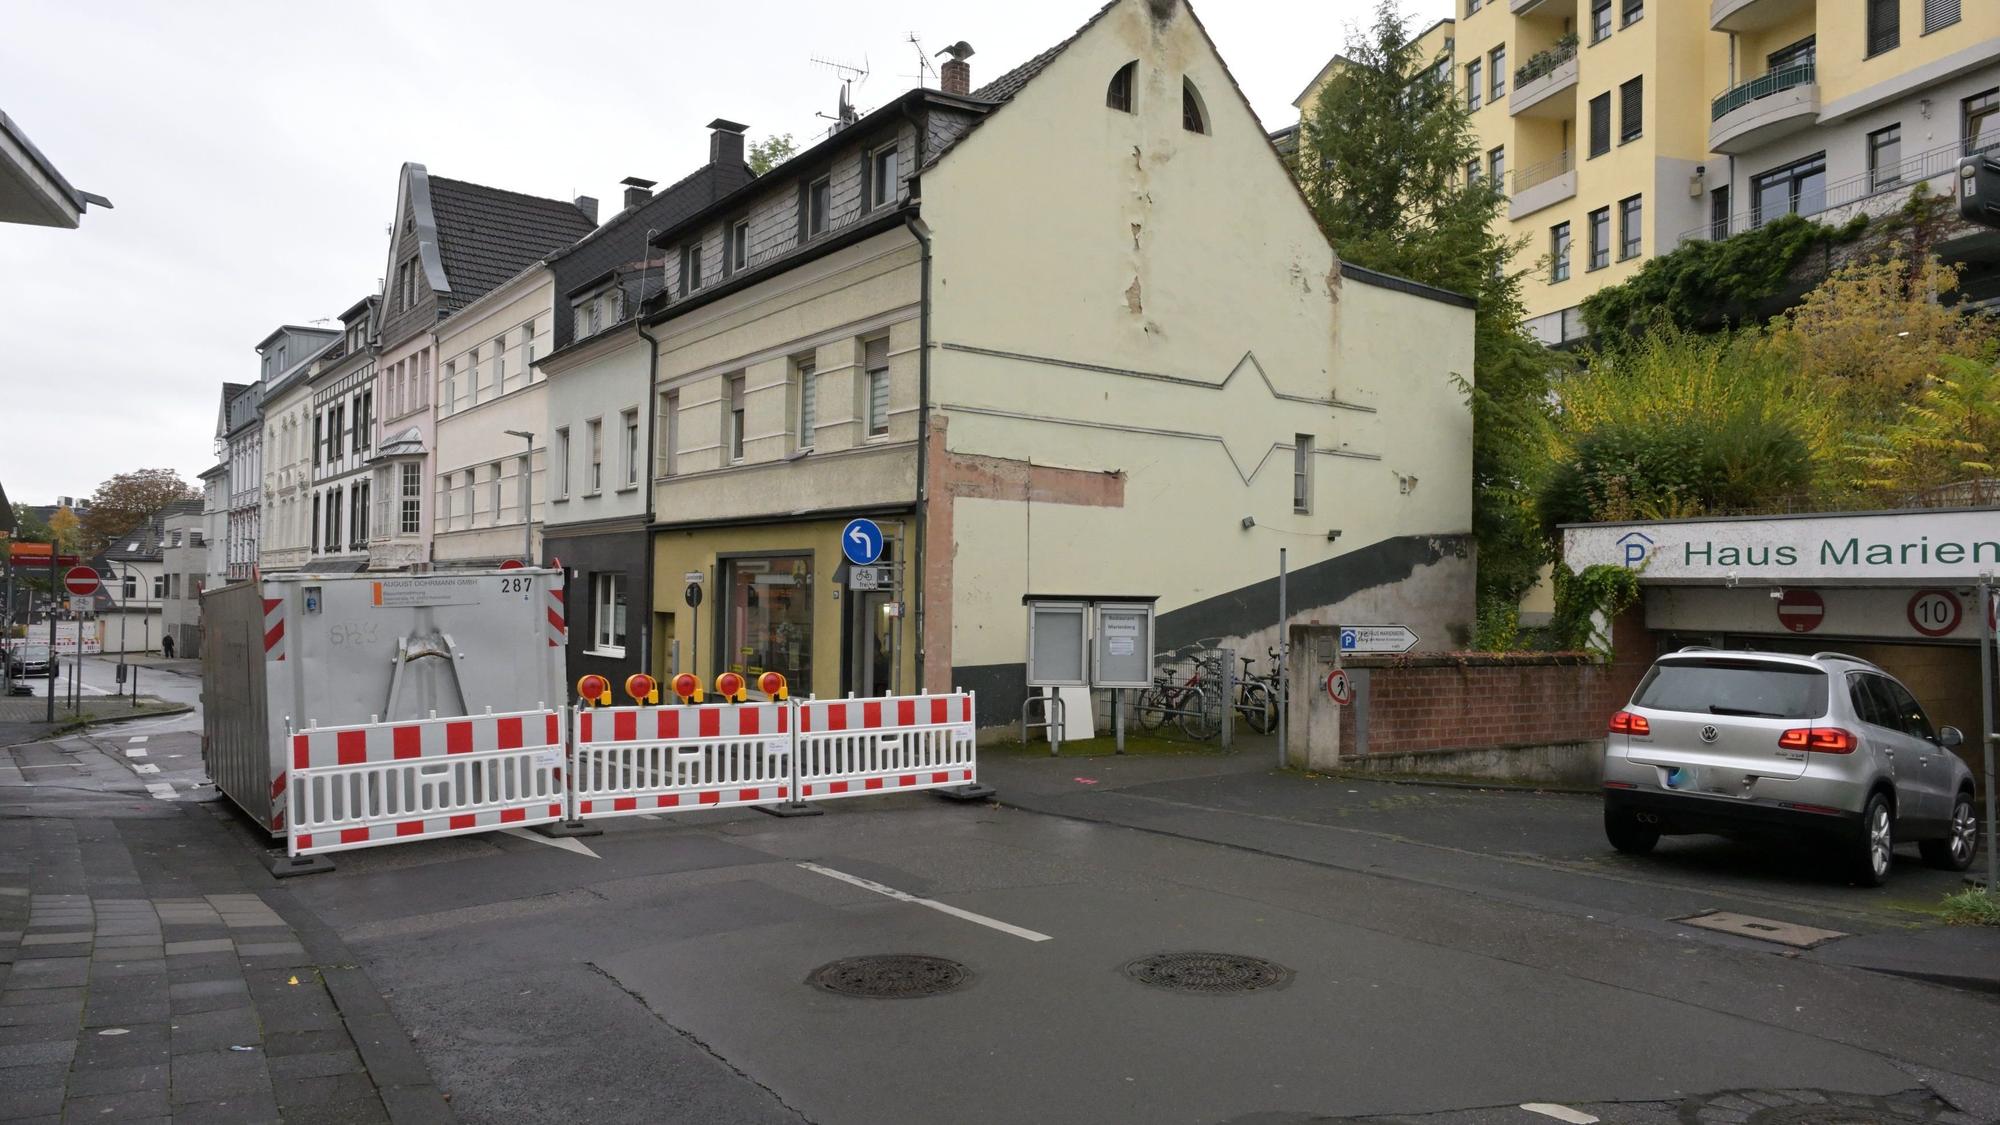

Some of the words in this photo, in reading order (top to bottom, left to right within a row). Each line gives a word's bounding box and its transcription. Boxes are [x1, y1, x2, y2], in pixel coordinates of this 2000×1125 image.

[1684, 541, 1798, 566] Haus
[1819, 536, 2000, 566] Marien
[383, 580, 412, 588] AUGUST
[414, 579, 455, 587] DOHRMANN
[502, 578, 532, 593] 287
[1919, 600, 1948, 624] 10
